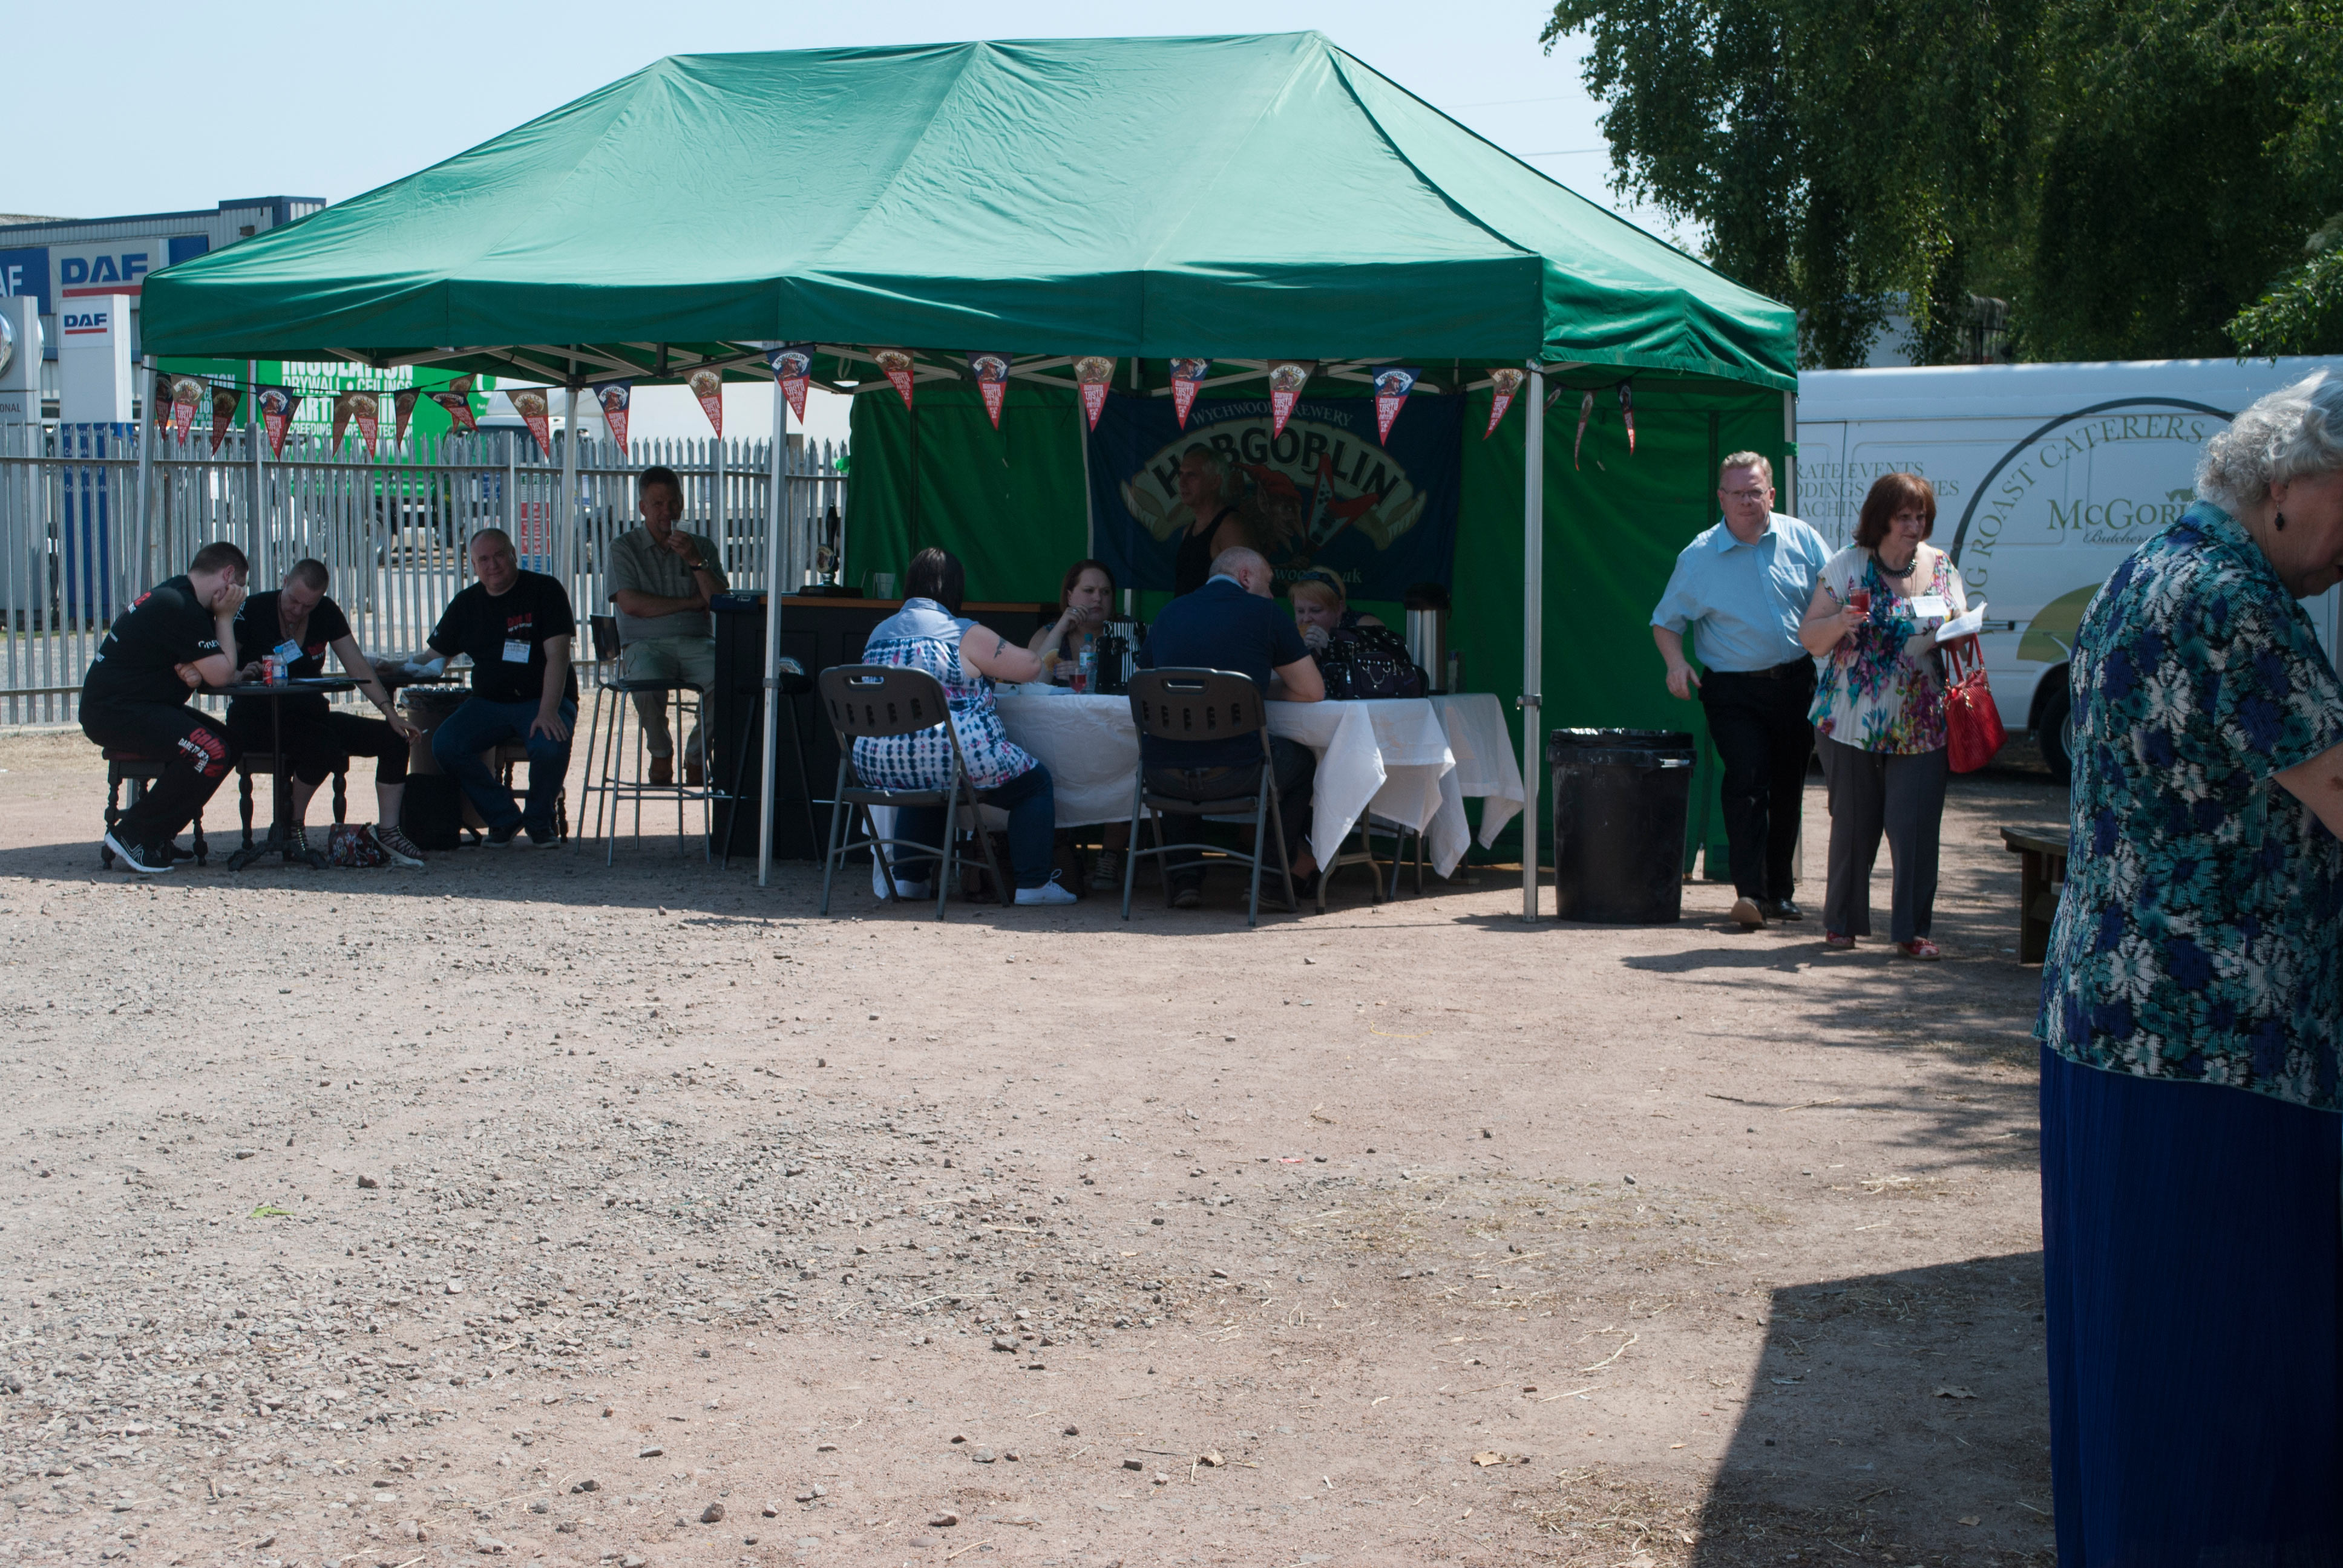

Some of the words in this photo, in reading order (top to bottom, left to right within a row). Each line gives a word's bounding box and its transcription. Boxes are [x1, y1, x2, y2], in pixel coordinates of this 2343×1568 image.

[61, 253, 148, 284] DAF
[64, 313, 107, 327] DAF
[1081, 357, 1107, 365] GOLD
[693, 372, 715, 382] GOLD
[1277, 365, 1300, 374] GOLD
[1292, 402, 1354, 427] REWERY
[289, 423, 332, 436] CREEDING
[1152, 427, 1400, 506] HBGOBLIN
[1847, 462, 1924, 479] EVENTS
[1970, 462, 2036, 558] ROAST
[2039, 415, 2205, 468] CATERERS
